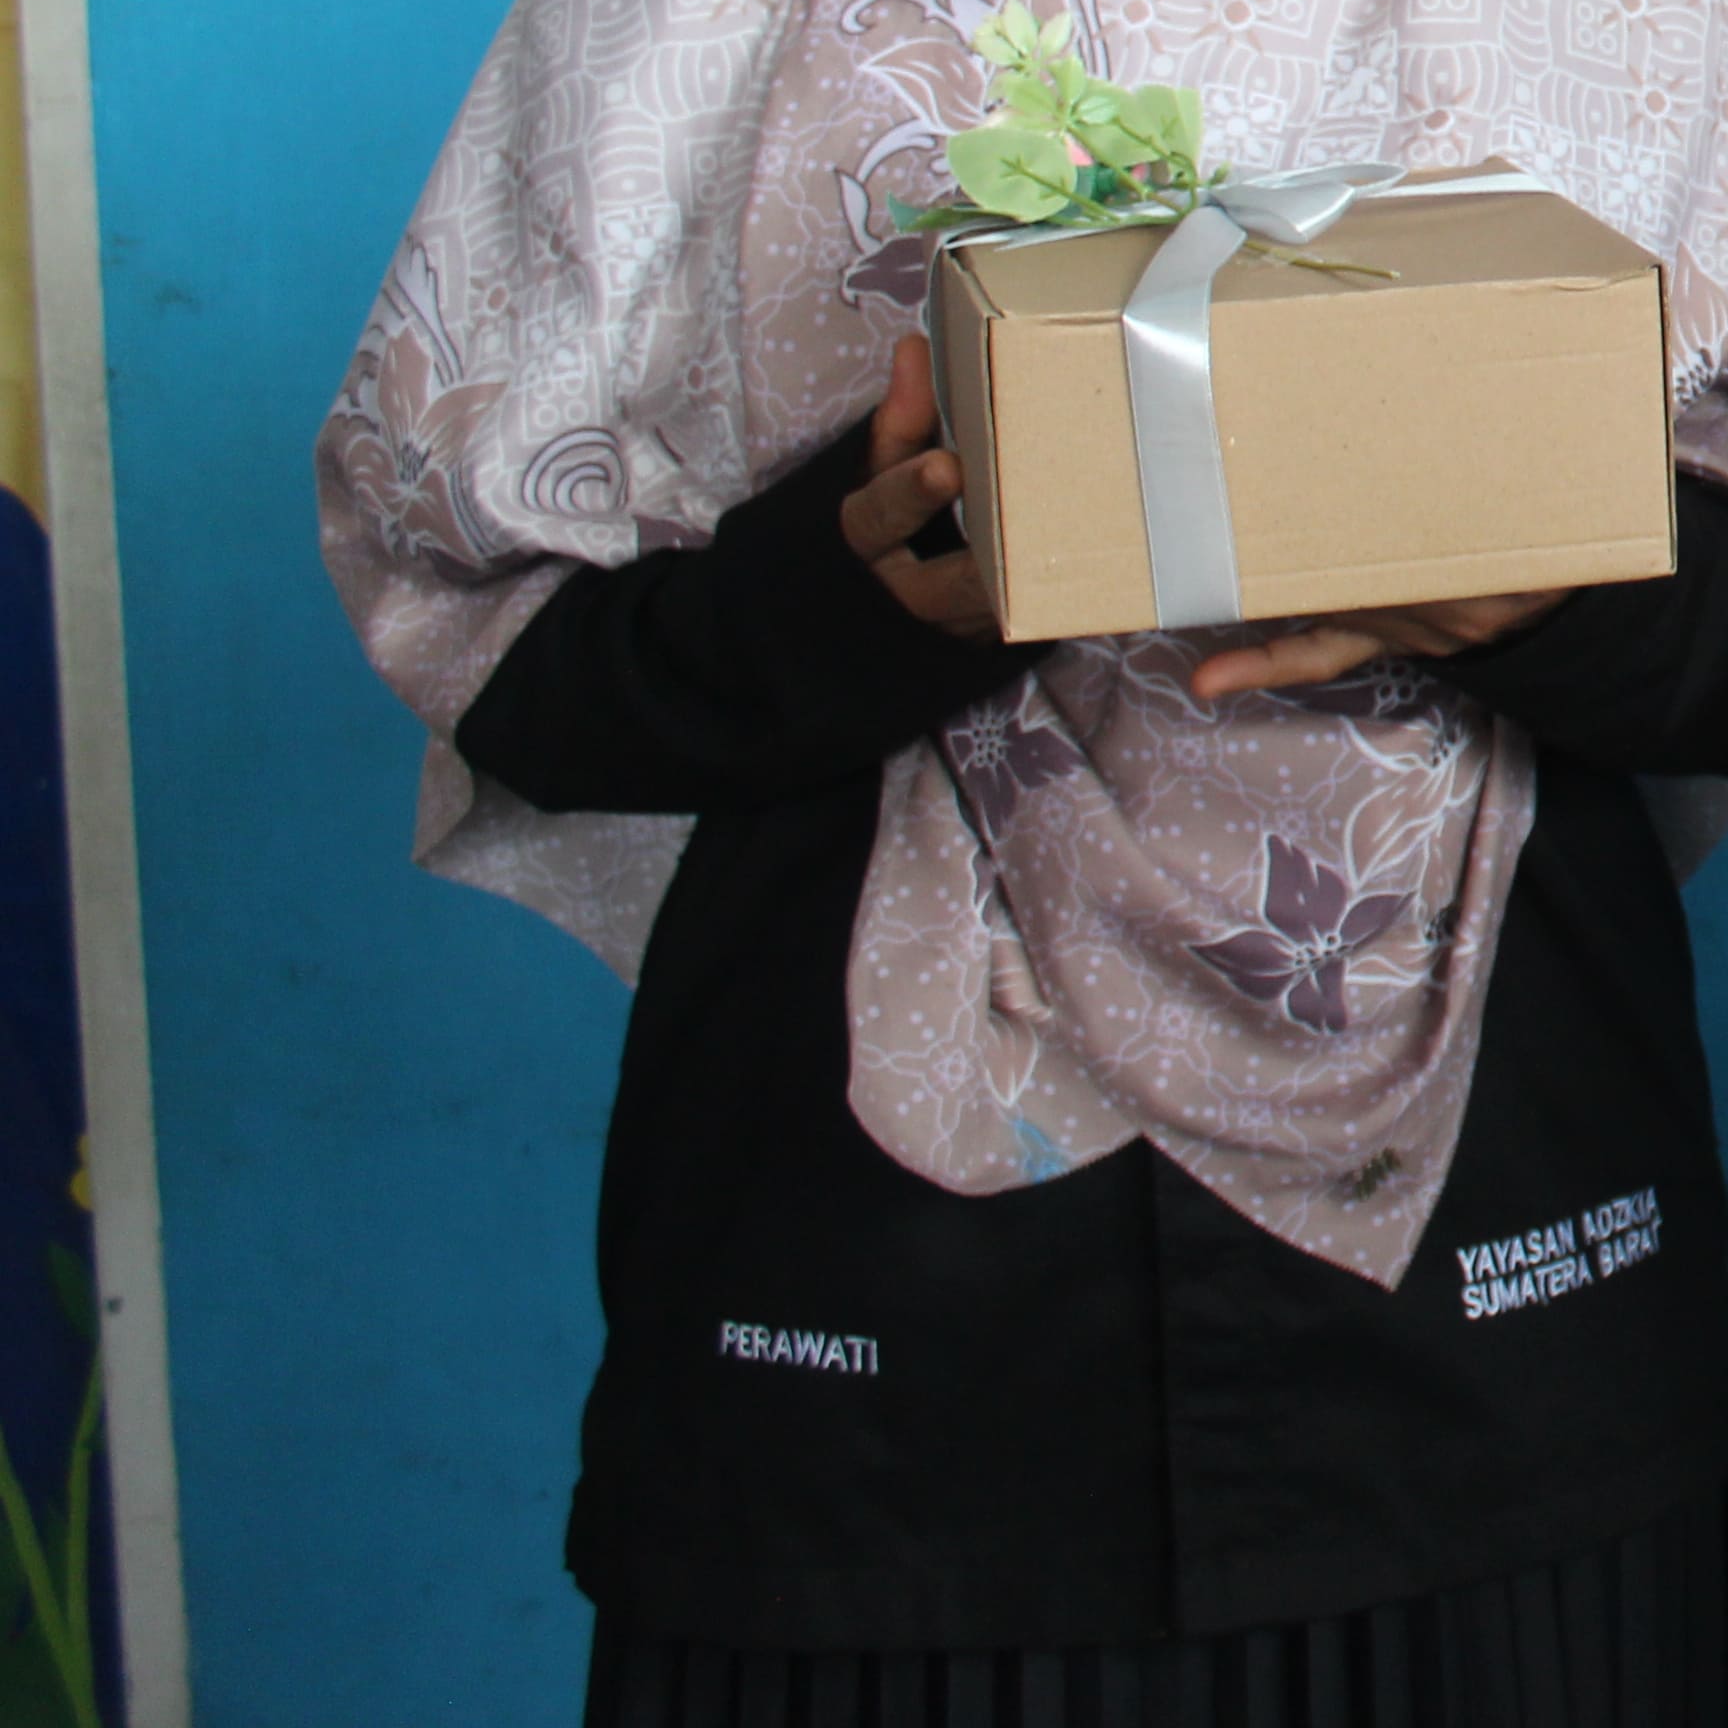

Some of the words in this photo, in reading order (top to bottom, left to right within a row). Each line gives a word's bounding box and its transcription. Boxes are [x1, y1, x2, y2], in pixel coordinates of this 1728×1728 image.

[1456, 1217, 1577, 1284] YAYASAN
[1581, 1186, 1659, 1246] ADZKIA
[1461, 1253, 1594, 1320] SUMATERA
[1597, 1217, 1663, 1279] BARAT
[720, 1320, 879, 1376] PERAWATI
